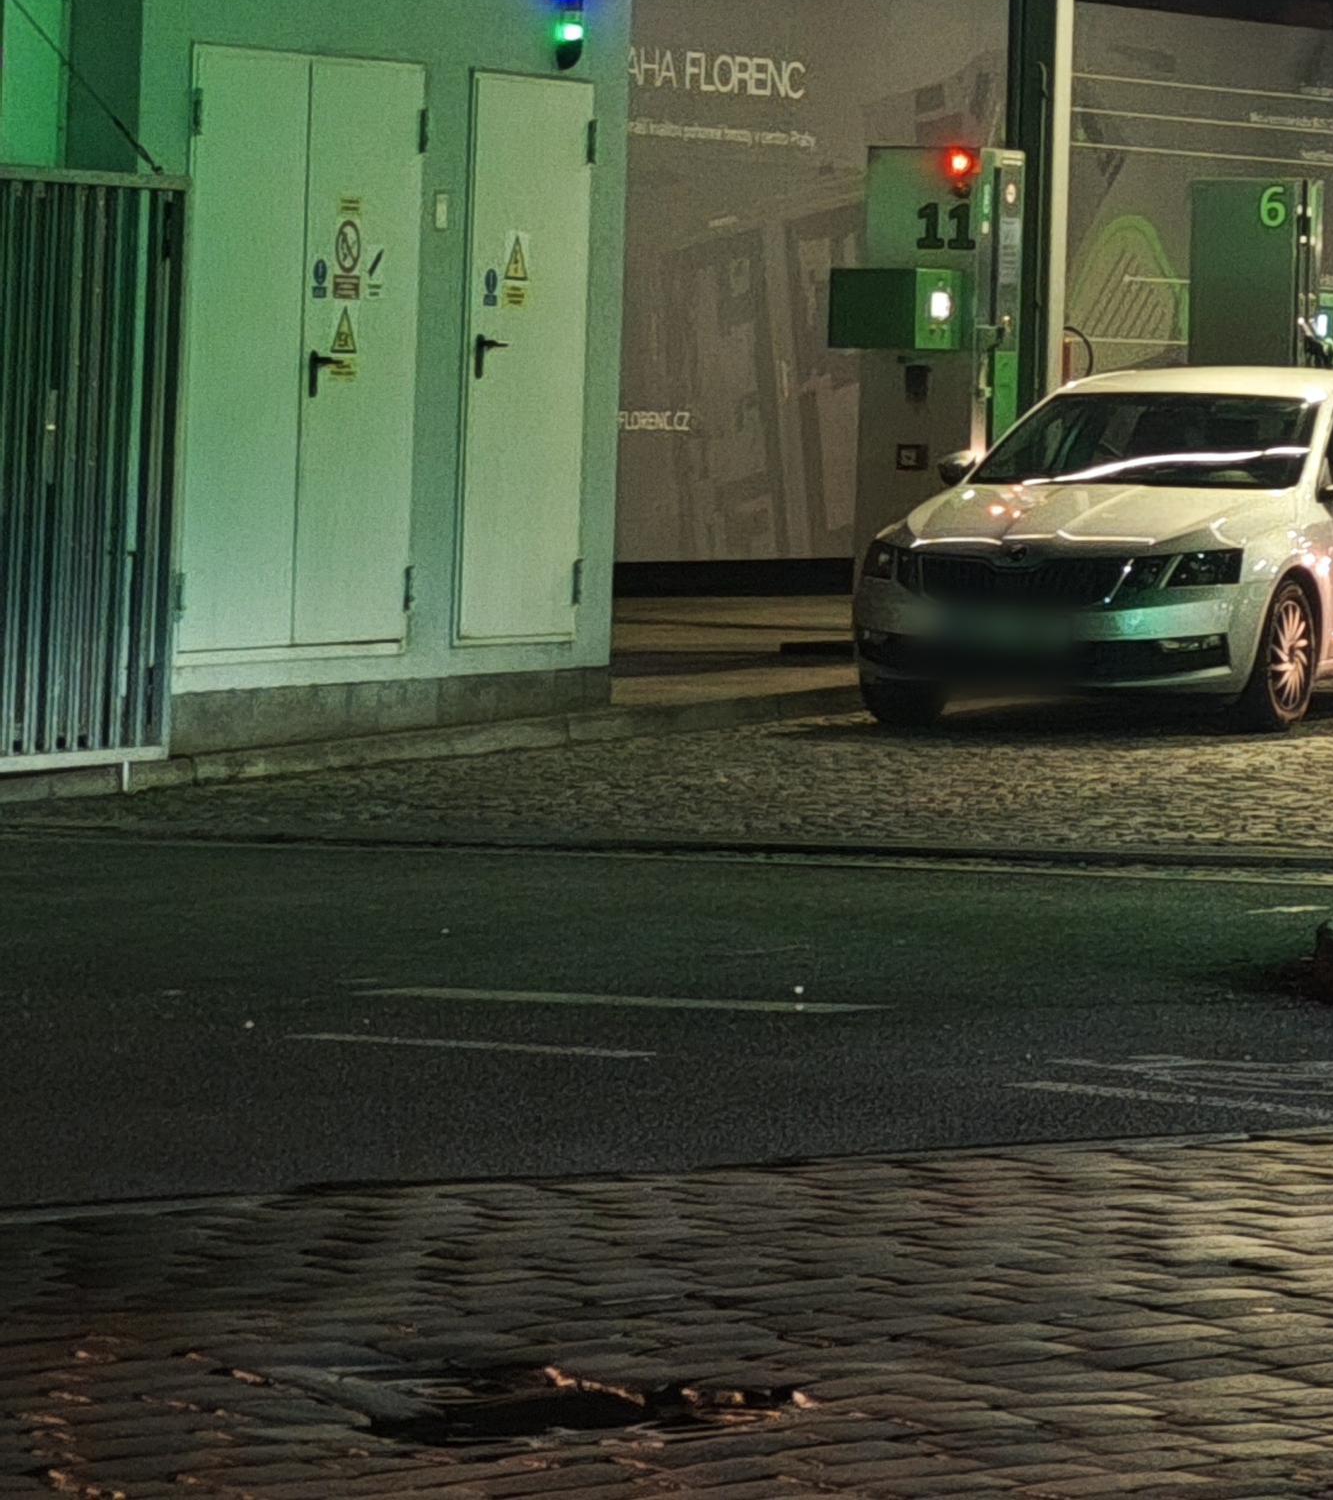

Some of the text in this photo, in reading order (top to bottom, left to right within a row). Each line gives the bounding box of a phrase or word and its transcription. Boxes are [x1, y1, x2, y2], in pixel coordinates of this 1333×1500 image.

[685, 51, 806, 100] FLORENC
[917, 202, 976, 250] 11
[1260, 186, 1286, 227] 6
